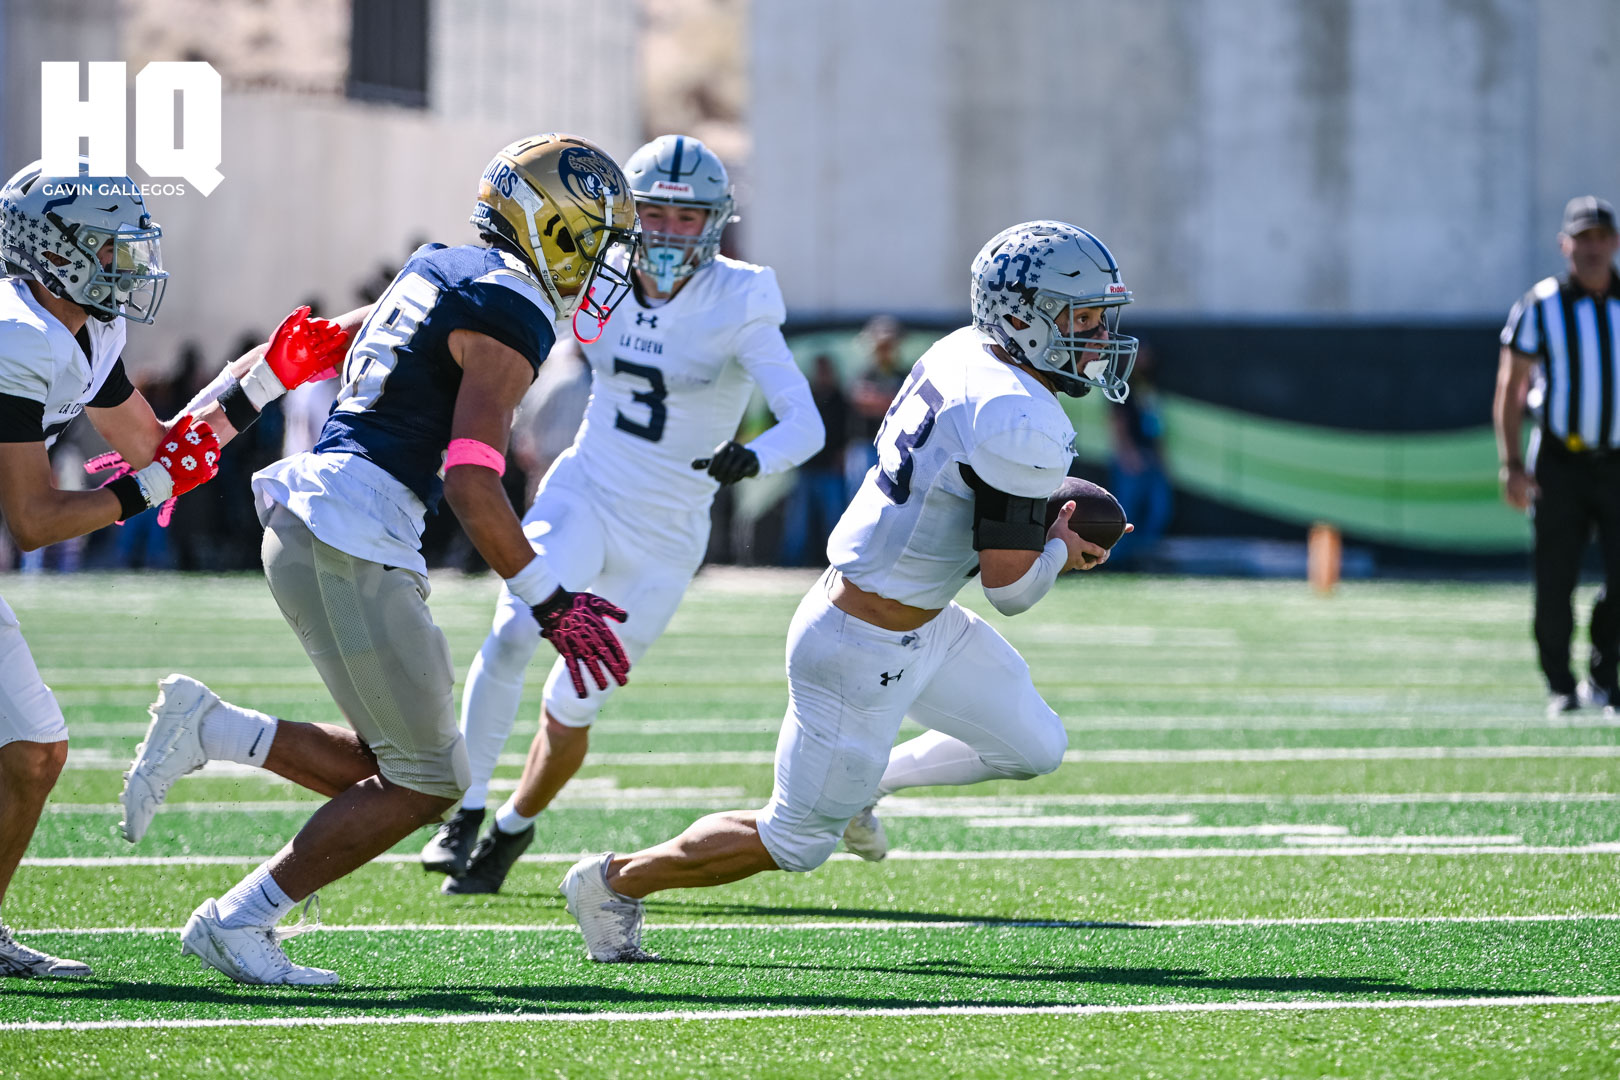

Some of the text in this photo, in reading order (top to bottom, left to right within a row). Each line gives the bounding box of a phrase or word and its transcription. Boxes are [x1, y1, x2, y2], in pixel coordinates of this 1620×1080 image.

[988, 254, 1032, 293] 33
[619, 334, 631, 347] LA
[612, 356, 668, 444] 3
